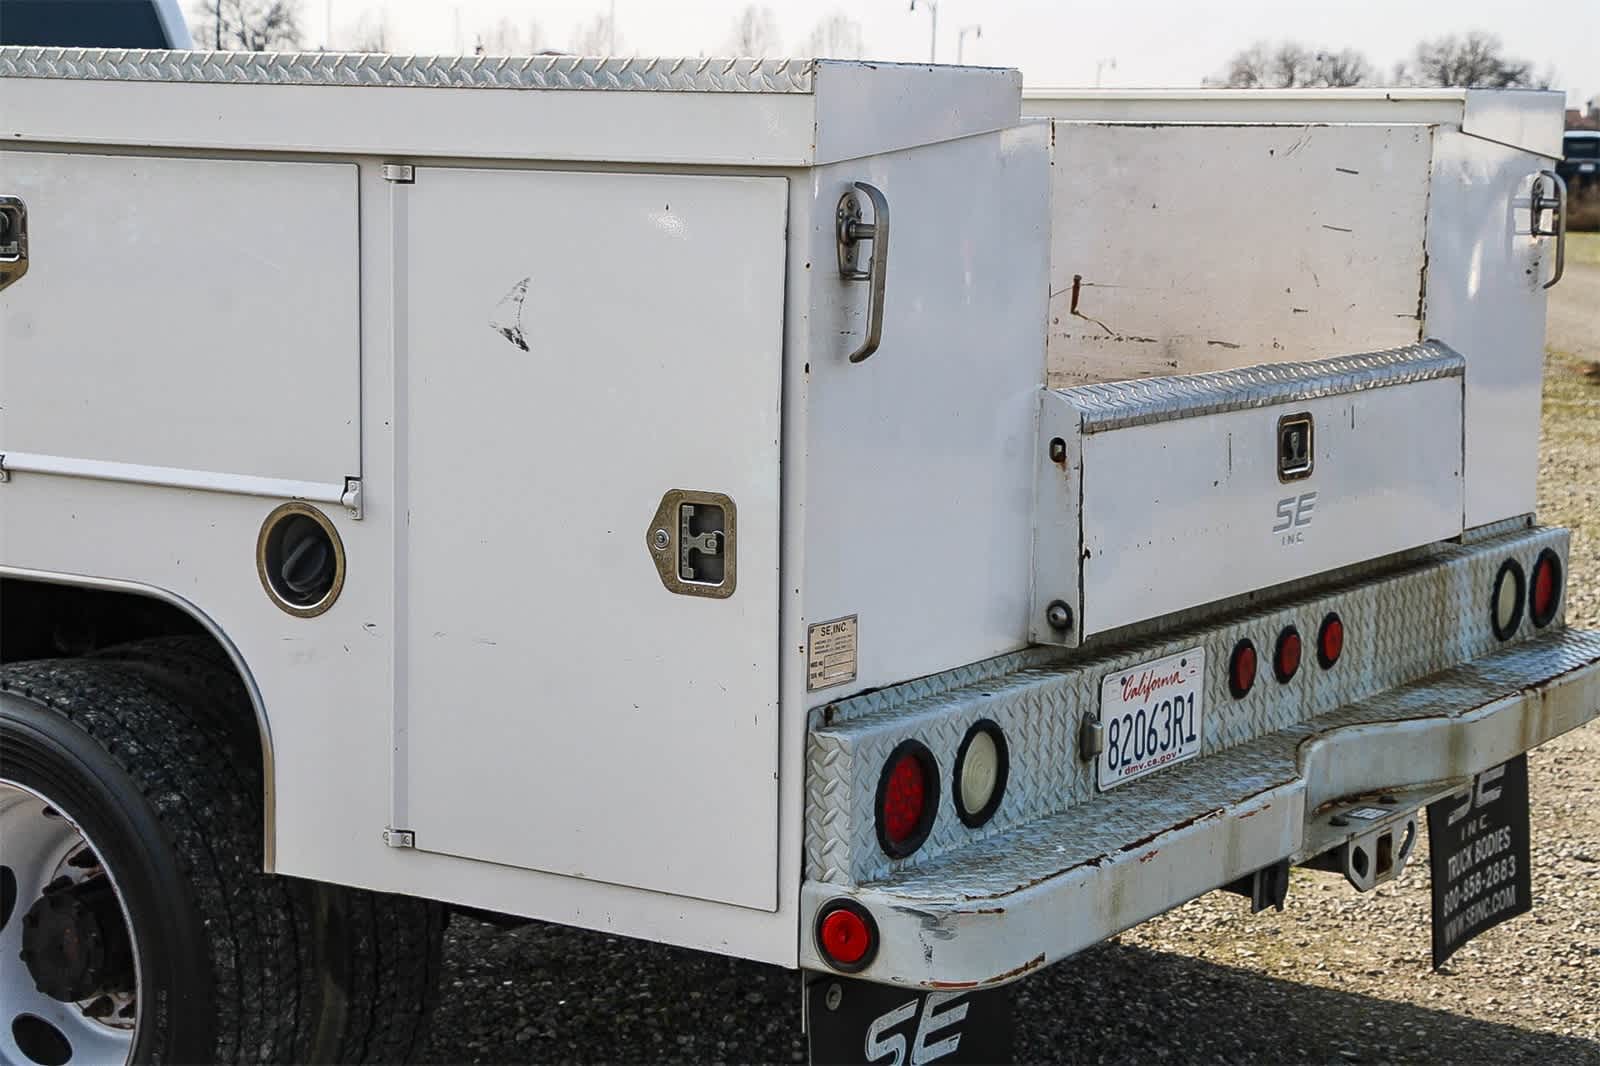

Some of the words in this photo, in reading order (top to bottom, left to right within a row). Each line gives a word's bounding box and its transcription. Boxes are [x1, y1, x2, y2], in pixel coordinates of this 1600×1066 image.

[1272, 491, 1318, 533] SE
[1281, 532, 1304, 546] INC
[1122, 669, 1186, 704] California
[1108, 691, 1197, 771] 82063R1
[1124, 751, 1178, 776] dmv.ca.gov
[1461, 814, 1489, 841] INC
[1447, 846, 1474, 882] TRUCK
[1474, 825, 1512, 863] BODIES
[1444, 884, 1517, 946] WWW.SEINC.COM
